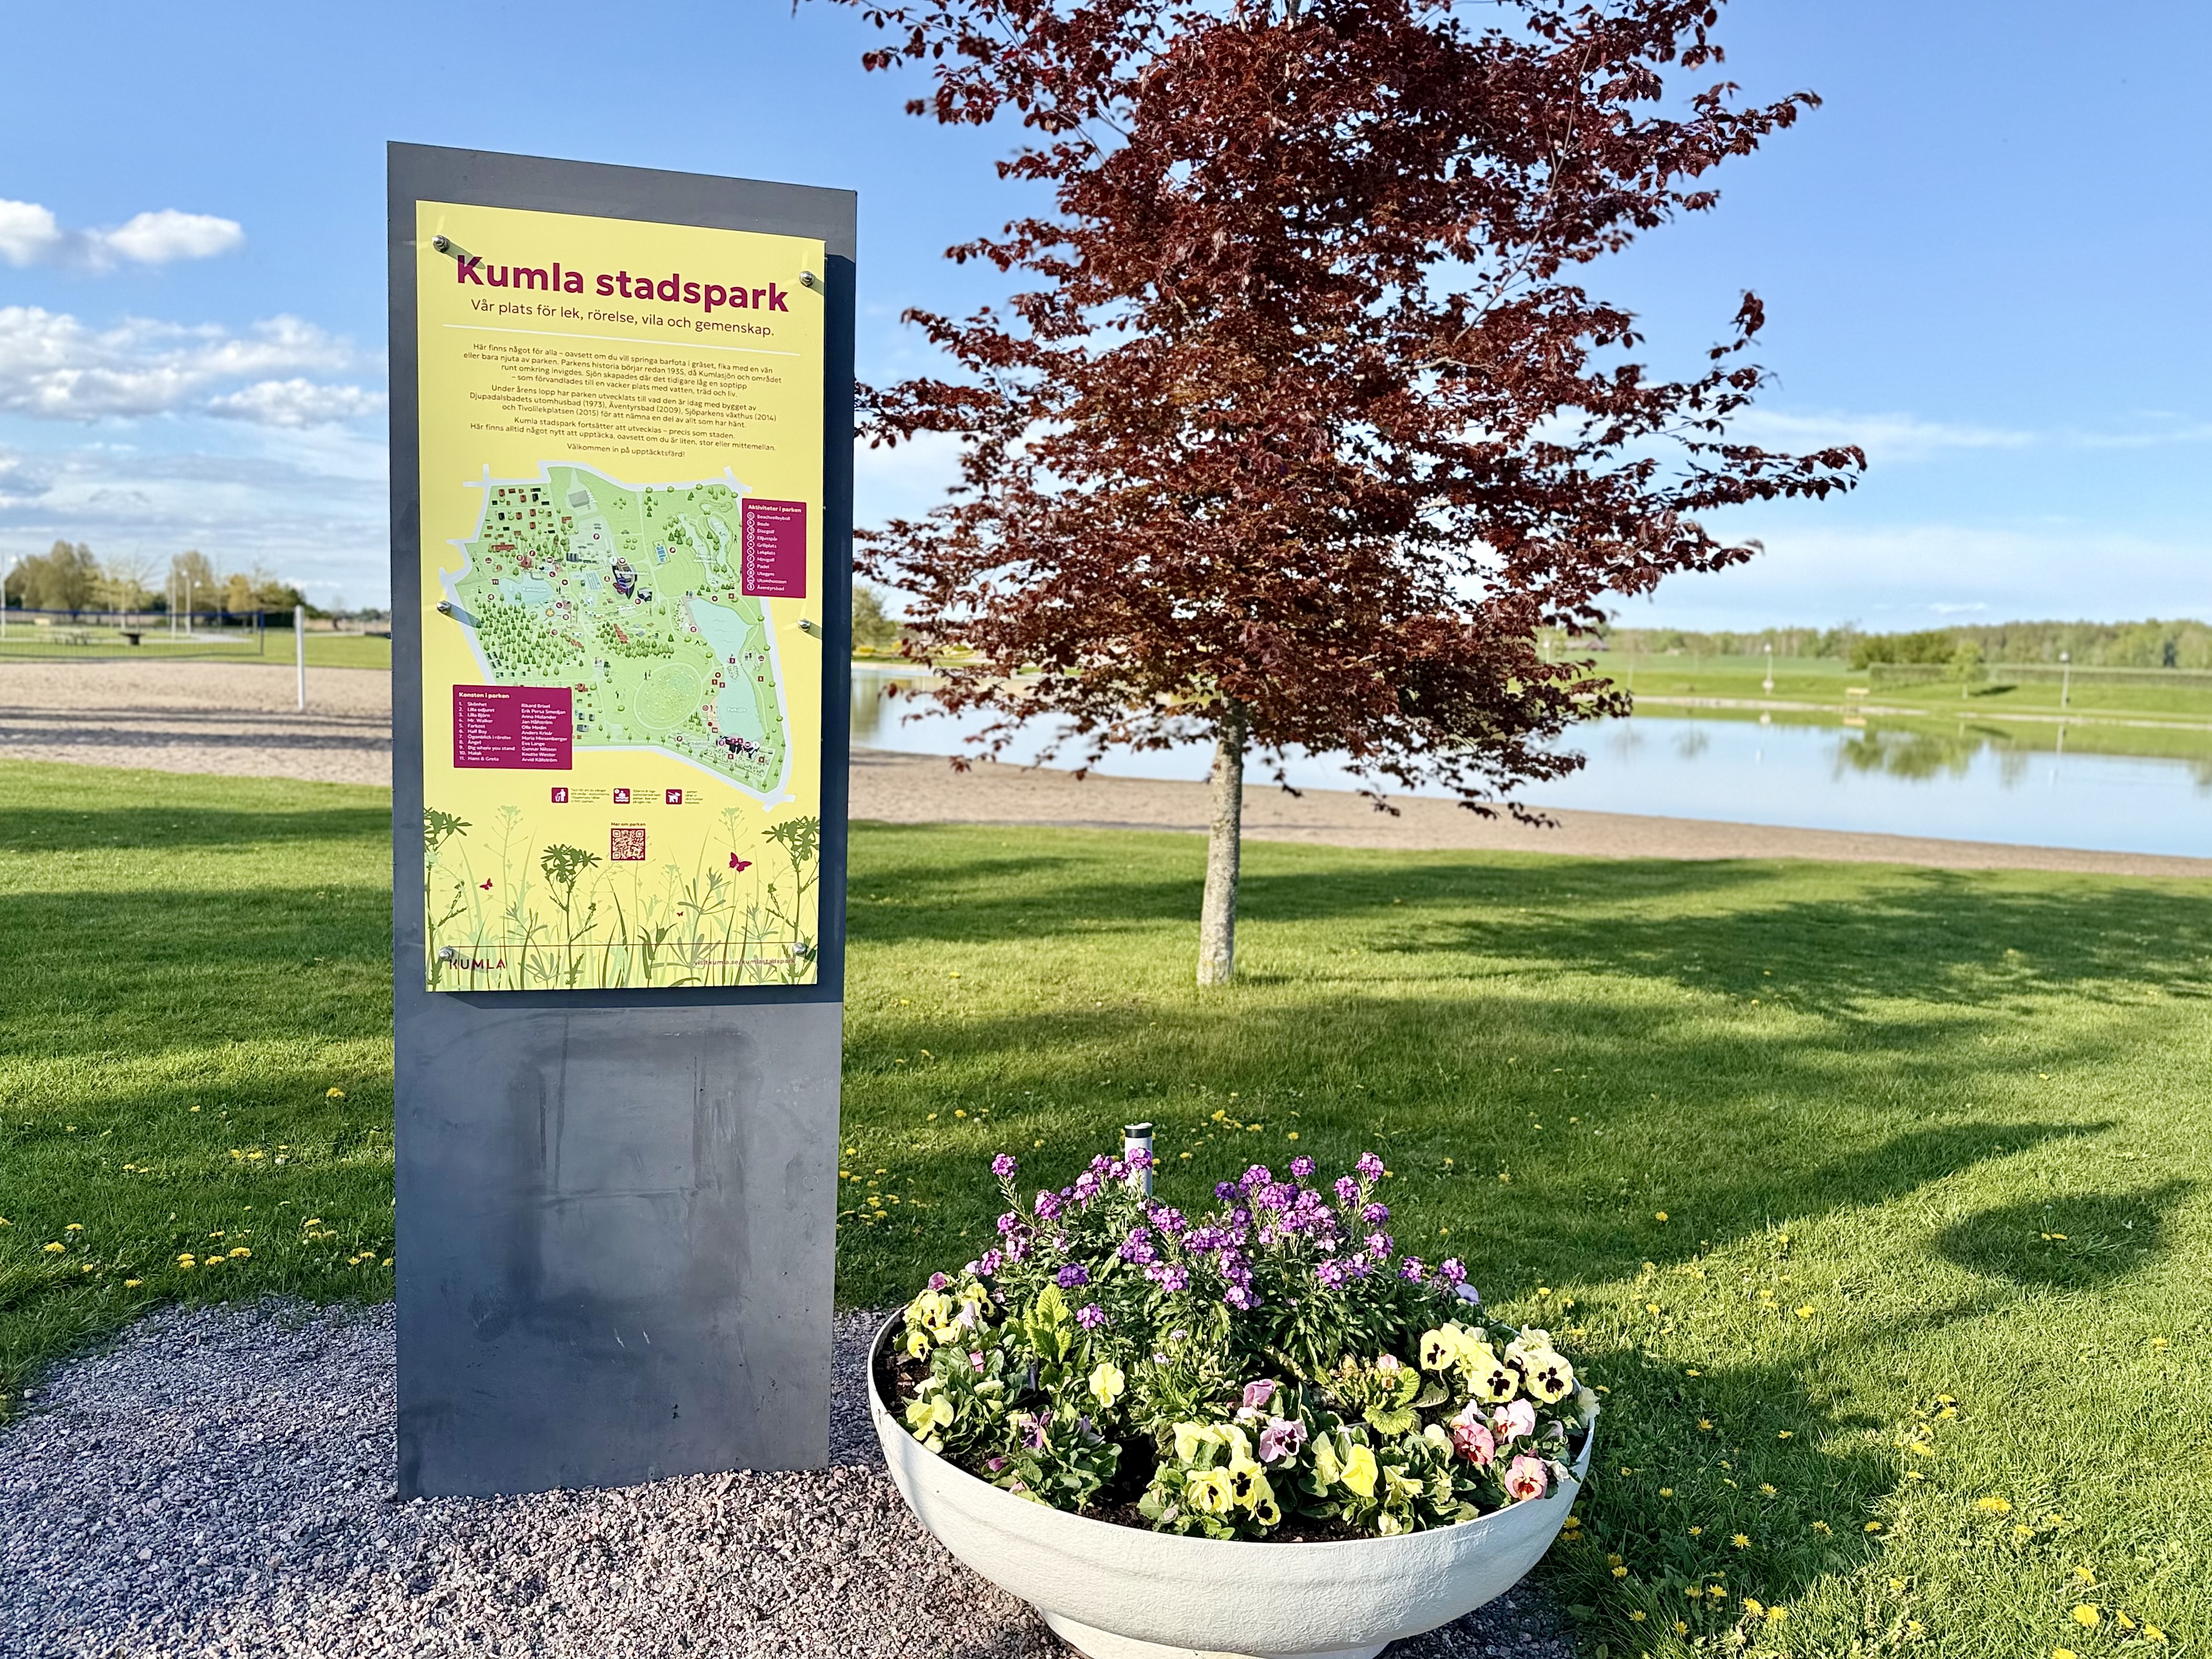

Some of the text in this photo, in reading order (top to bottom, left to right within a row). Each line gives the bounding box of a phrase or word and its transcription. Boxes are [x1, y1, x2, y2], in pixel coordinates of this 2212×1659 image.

[457, 255, 788, 313] Kumla stadspark
[471, 298, 773, 337] Vår plats för lek, rörelse, vila och gemenskap.
[489, 344, 507, 352] finns
[509, 346, 530, 355] något
[631, 357, 658, 365] springa
[660, 358, 686, 366] barfota
[692, 361, 716, 370] gräset,
[718, 362, 731, 370] fika
[501, 355, 519, 363] njuta
[531, 357, 559, 365] parken.
[562, 359, 590, 368] Parkens
[592, 361, 619, 370] historia
[622, 364, 643, 373] börjar
[667, 367, 686, 376] 1935,
[699, 370, 735, 380] Kumlasjön
[751, 375, 782, 384] området
[519, 366, 549, 376] omkring
[552, 367, 584, 376] invigdes.
[586, 370, 601, 379] Sjön
[604, 372, 637, 381] skapades
[667, 376, 695, 386] tidigare
[697, 378, 707, 388] låg
[720, 382, 747, 391] soptipp
[535, 375, 582, 385] förvandlades
[632, 383, 650, 391] plats
[670, 387, 695, 395] vatten,
[470, 392, 776, 421] Djupadalsbadets utomhusbad (1973), Äventyrsbad (2009), Sjöparkens växthus (2014)
[492, 384, 515, 392] Under
[516, 385, 537, 394] årens
[539, 388, 555, 397] lopp
[599, 394, 636, 402] utvecklats
[687, 399, 702, 408] idag
[722, 402, 746, 411] bygget
[515, 417, 537, 425] Kumla
[540, 419, 576, 427] stadspark
[578, 421, 614, 430] fortsätter
[518, 404, 574, 415] Tivolilekplatsen
[576, 408, 599, 417] (2015)
[729, 420, 746, 428] hänt.
[486, 423, 504, 431] finns
[505, 425, 524, 433] alltid
[526, 426, 548, 435] något
[579, 432, 615, 440] upptäcka,
[680, 438, 697, 446] liten,
[732, 442, 776, 451] mittemellan.
[567, 443, 610, 452] Välkommen
[621, 446, 629, 454] på
[632, 449, 685, 457] upptäcktsfärd!
[449, 958, 506, 970] KUMLA
